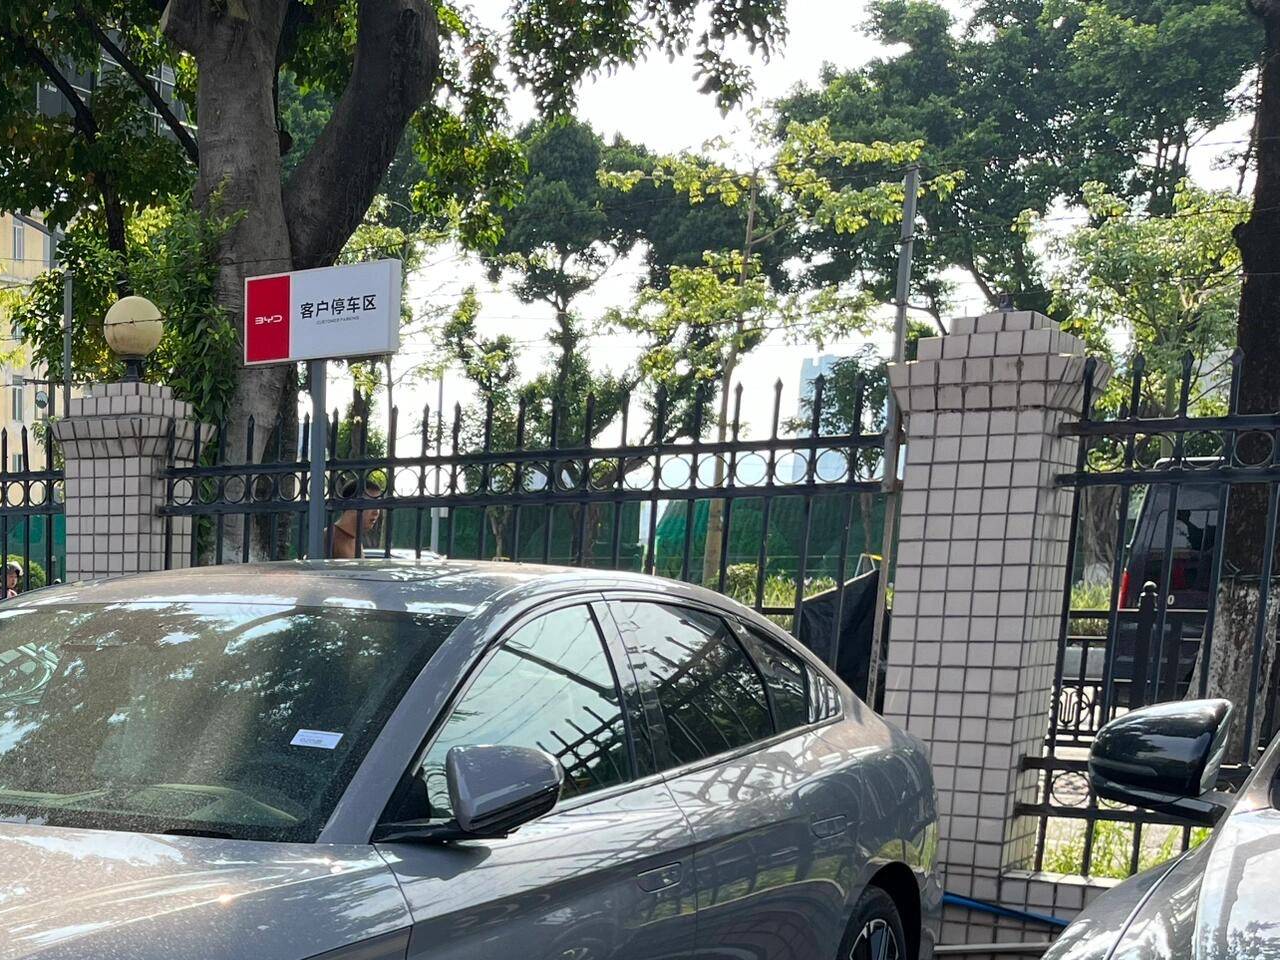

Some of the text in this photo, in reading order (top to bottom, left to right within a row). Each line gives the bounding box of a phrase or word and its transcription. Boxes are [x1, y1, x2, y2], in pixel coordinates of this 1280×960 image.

[300, 295, 376, 319] 客户停车区
[255, 315, 283, 325] BYD
